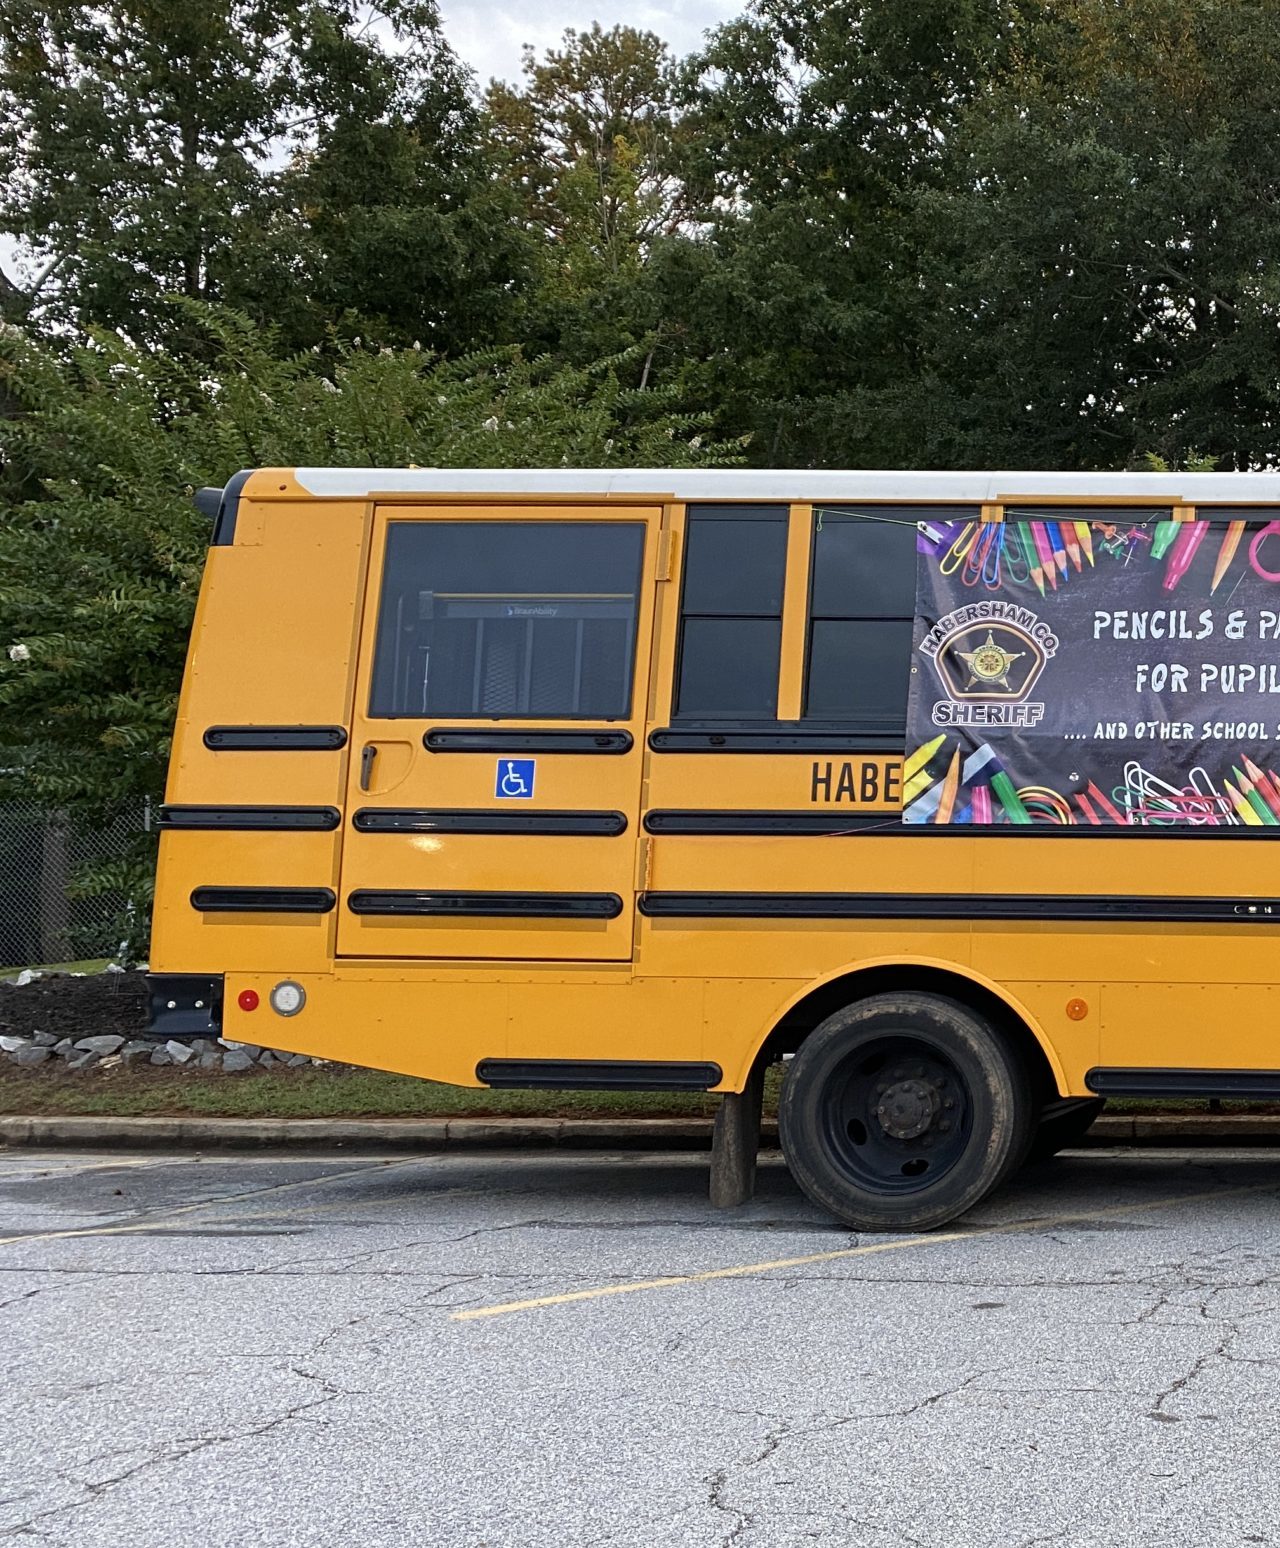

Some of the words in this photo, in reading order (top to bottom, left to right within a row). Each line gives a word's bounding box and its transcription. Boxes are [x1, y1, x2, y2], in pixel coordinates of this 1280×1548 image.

[920, 601, 1037, 656] HABERSHAM
[1032, 623, 1059, 658] CO.
[1093, 609, 1214, 640] PENCILS
[1225, 610, 1248, 640] &
[1136, 664, 1189, 693] FOR
[932, 701, 1044, 727] SHERIFF
[1093, 722, 1128, 740] AND
[1134, 720, 1195, 740] OTHER
[1200, 721, 1269, 741] SCHOOL
